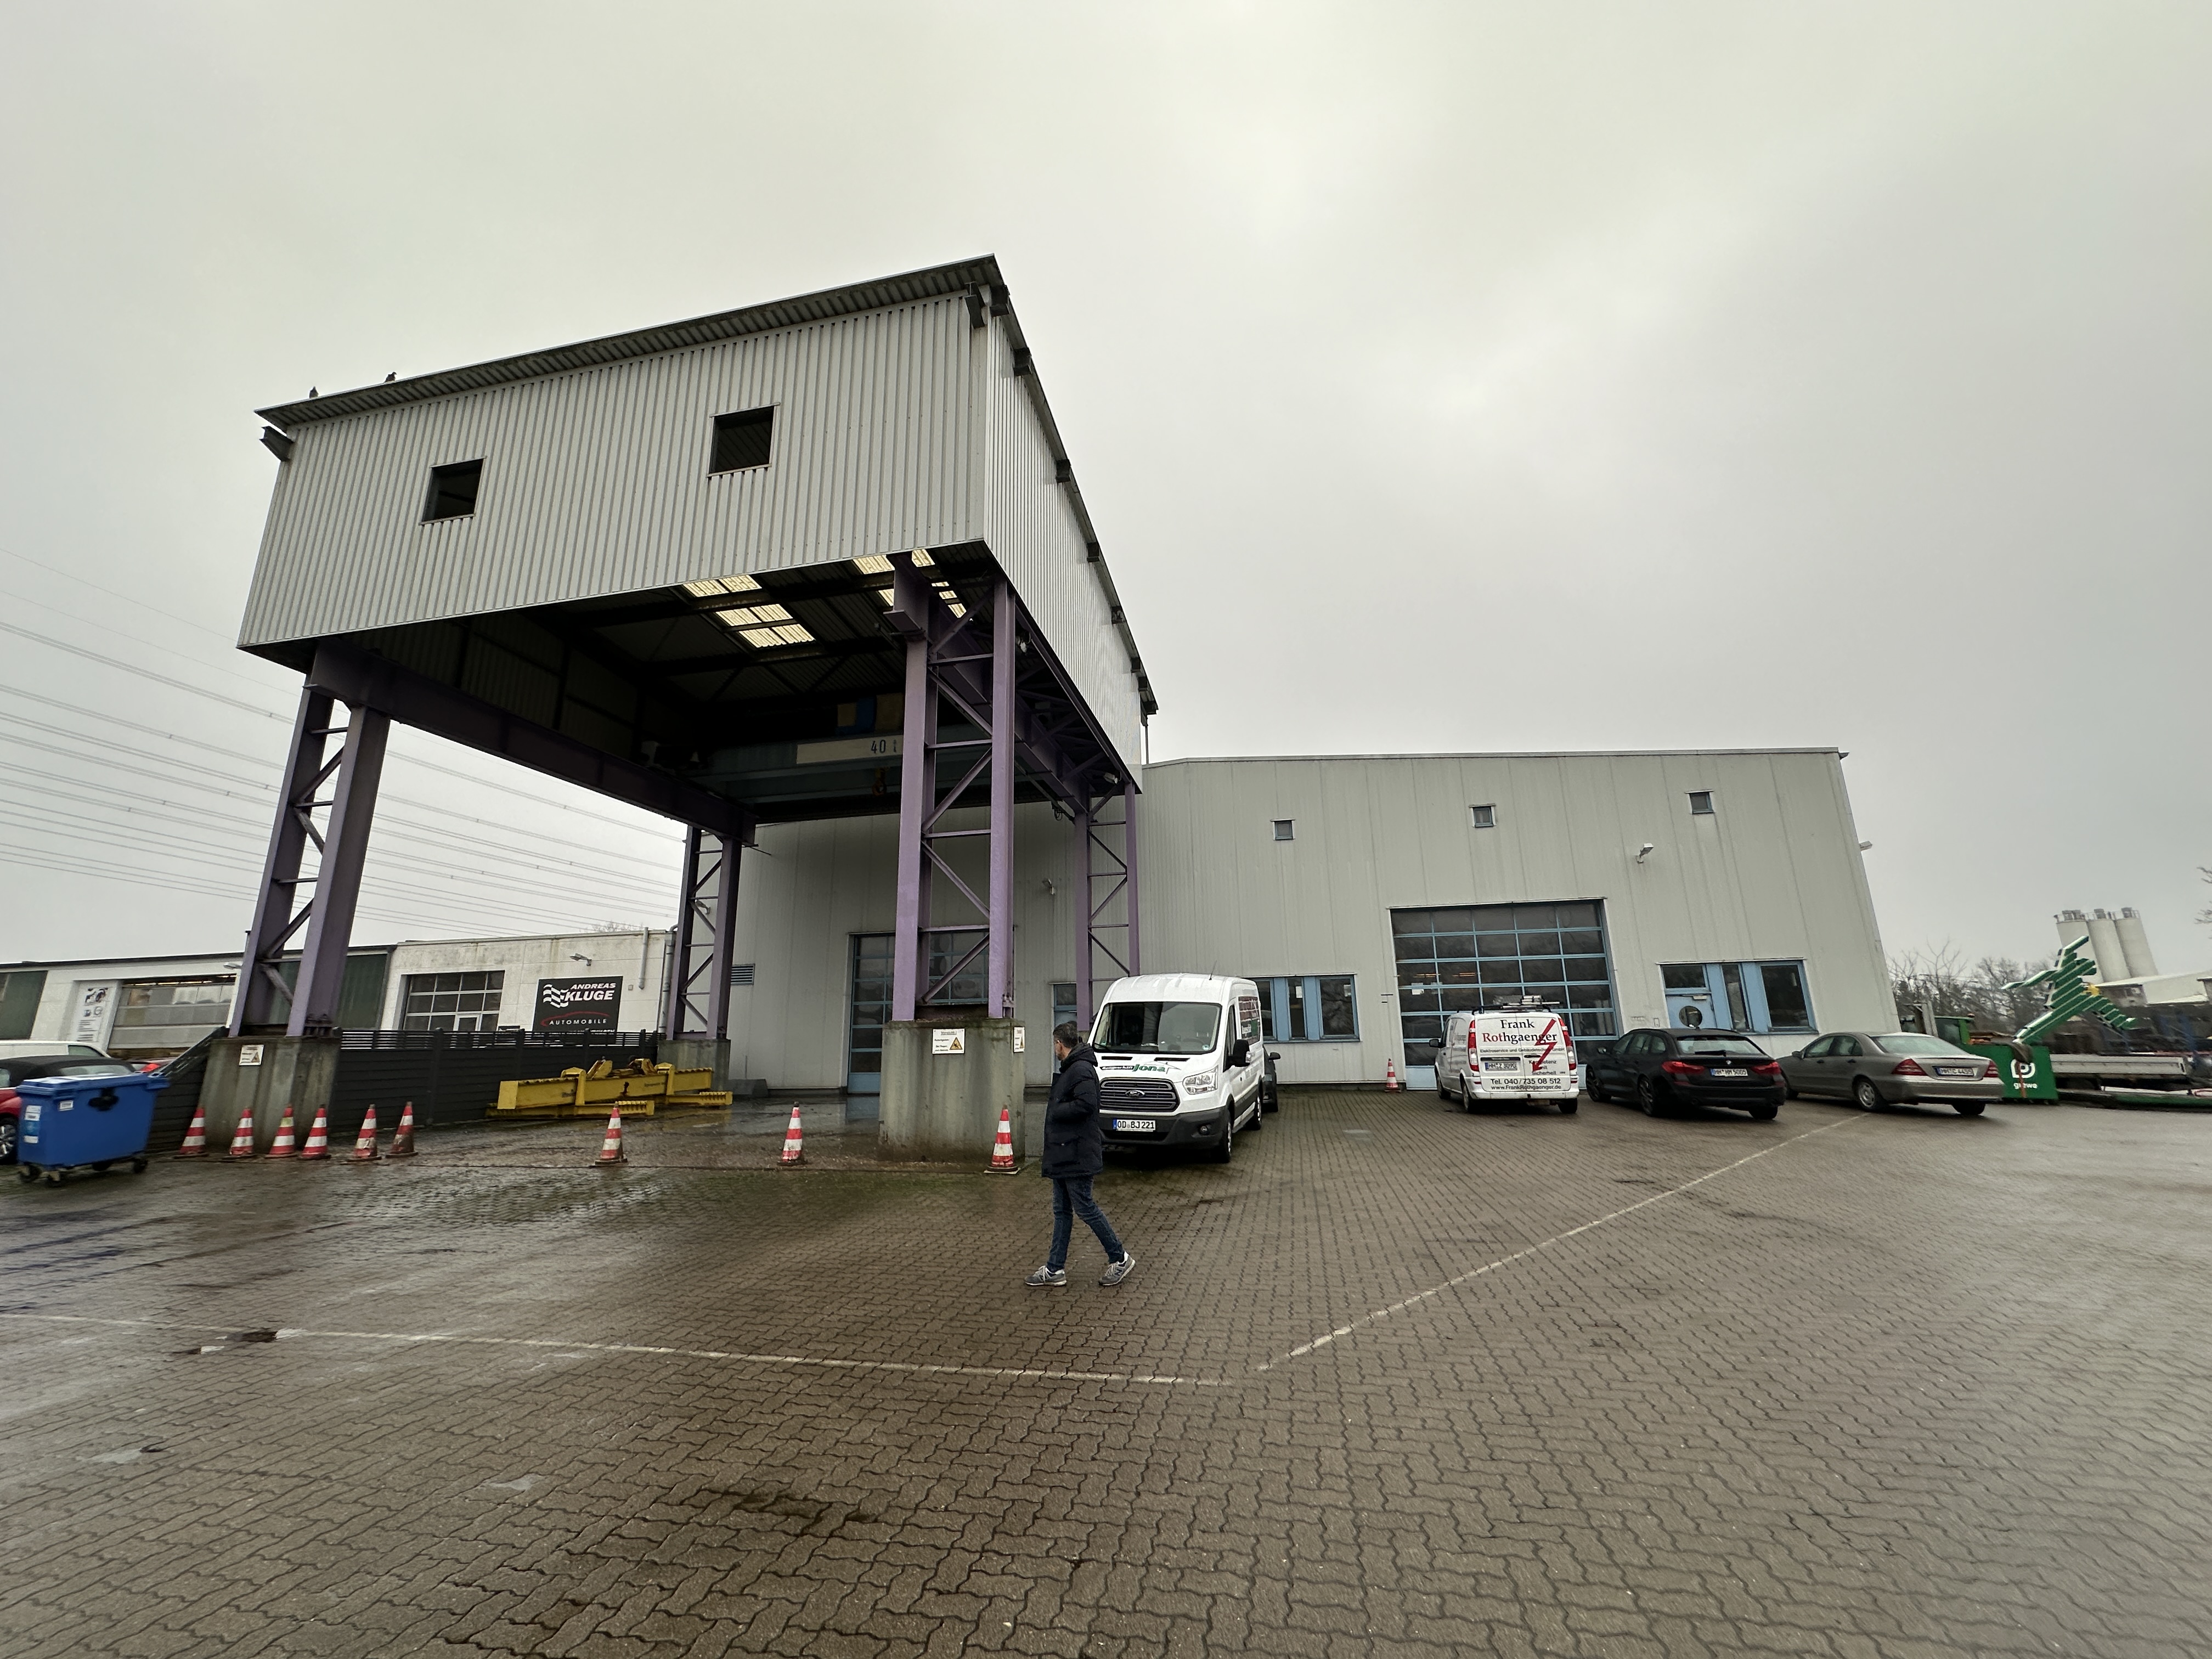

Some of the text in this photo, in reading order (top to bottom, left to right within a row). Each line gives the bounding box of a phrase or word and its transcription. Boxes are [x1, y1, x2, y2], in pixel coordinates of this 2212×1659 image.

[871, 740, 886, 754] 40
[564, 990, 615, 1001] KLUGE
[1500, 1019, 1535, 1029] Frank
[1482, 1032, 1558, 1045] Rothgaenger
[1132, 1064, 1166, 1072] Jona
[1131, 1121, 1140, 1129] BJ
